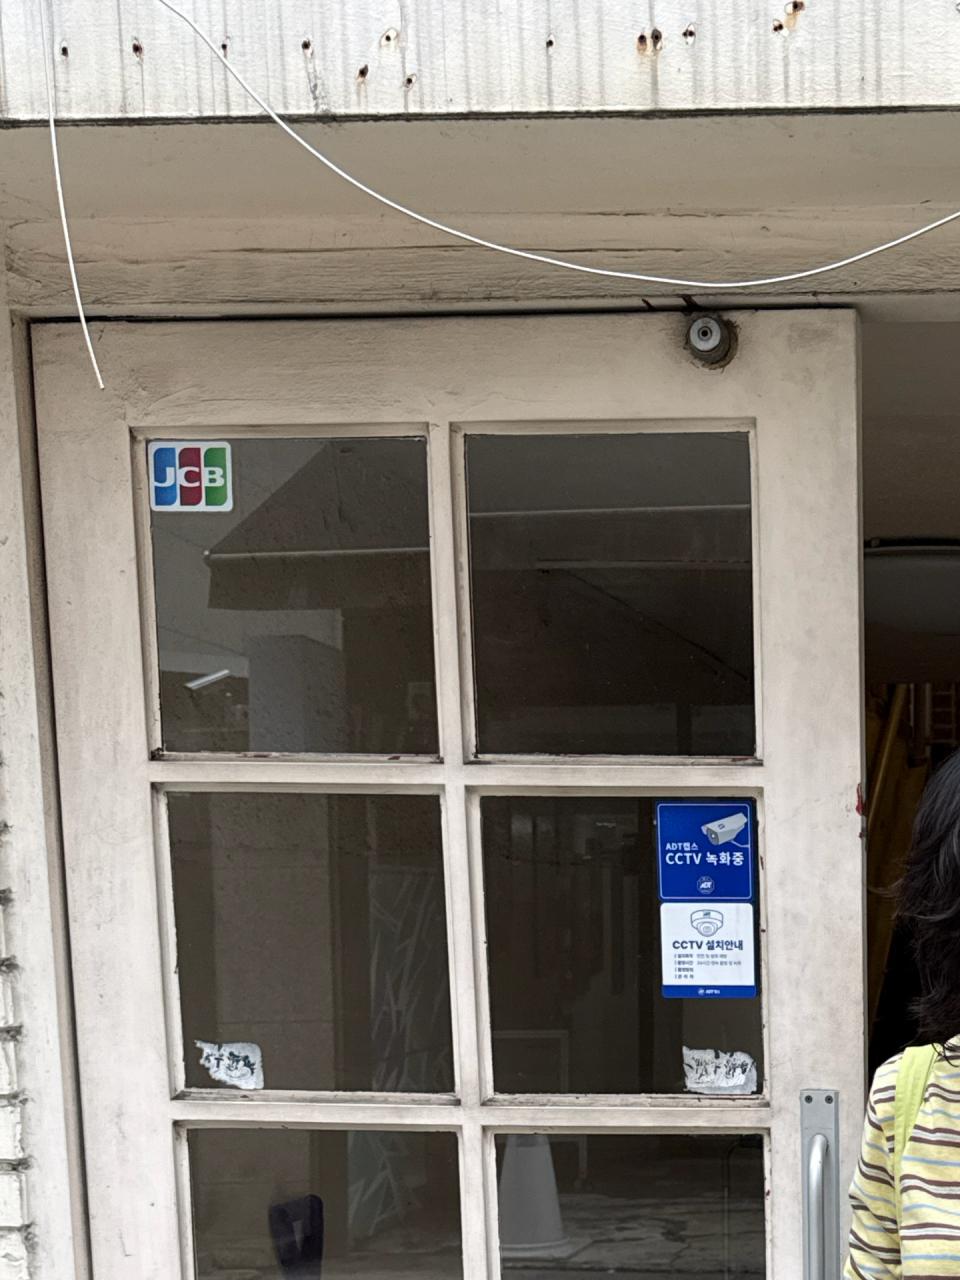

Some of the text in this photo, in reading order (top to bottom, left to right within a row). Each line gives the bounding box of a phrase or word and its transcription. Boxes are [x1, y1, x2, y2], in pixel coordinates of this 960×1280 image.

[154, 466, 225, 488] JCB
[665, 851, 745, 866] CCTV 녹화중
[672, 940, 744, 951] CCTV 설치안내
